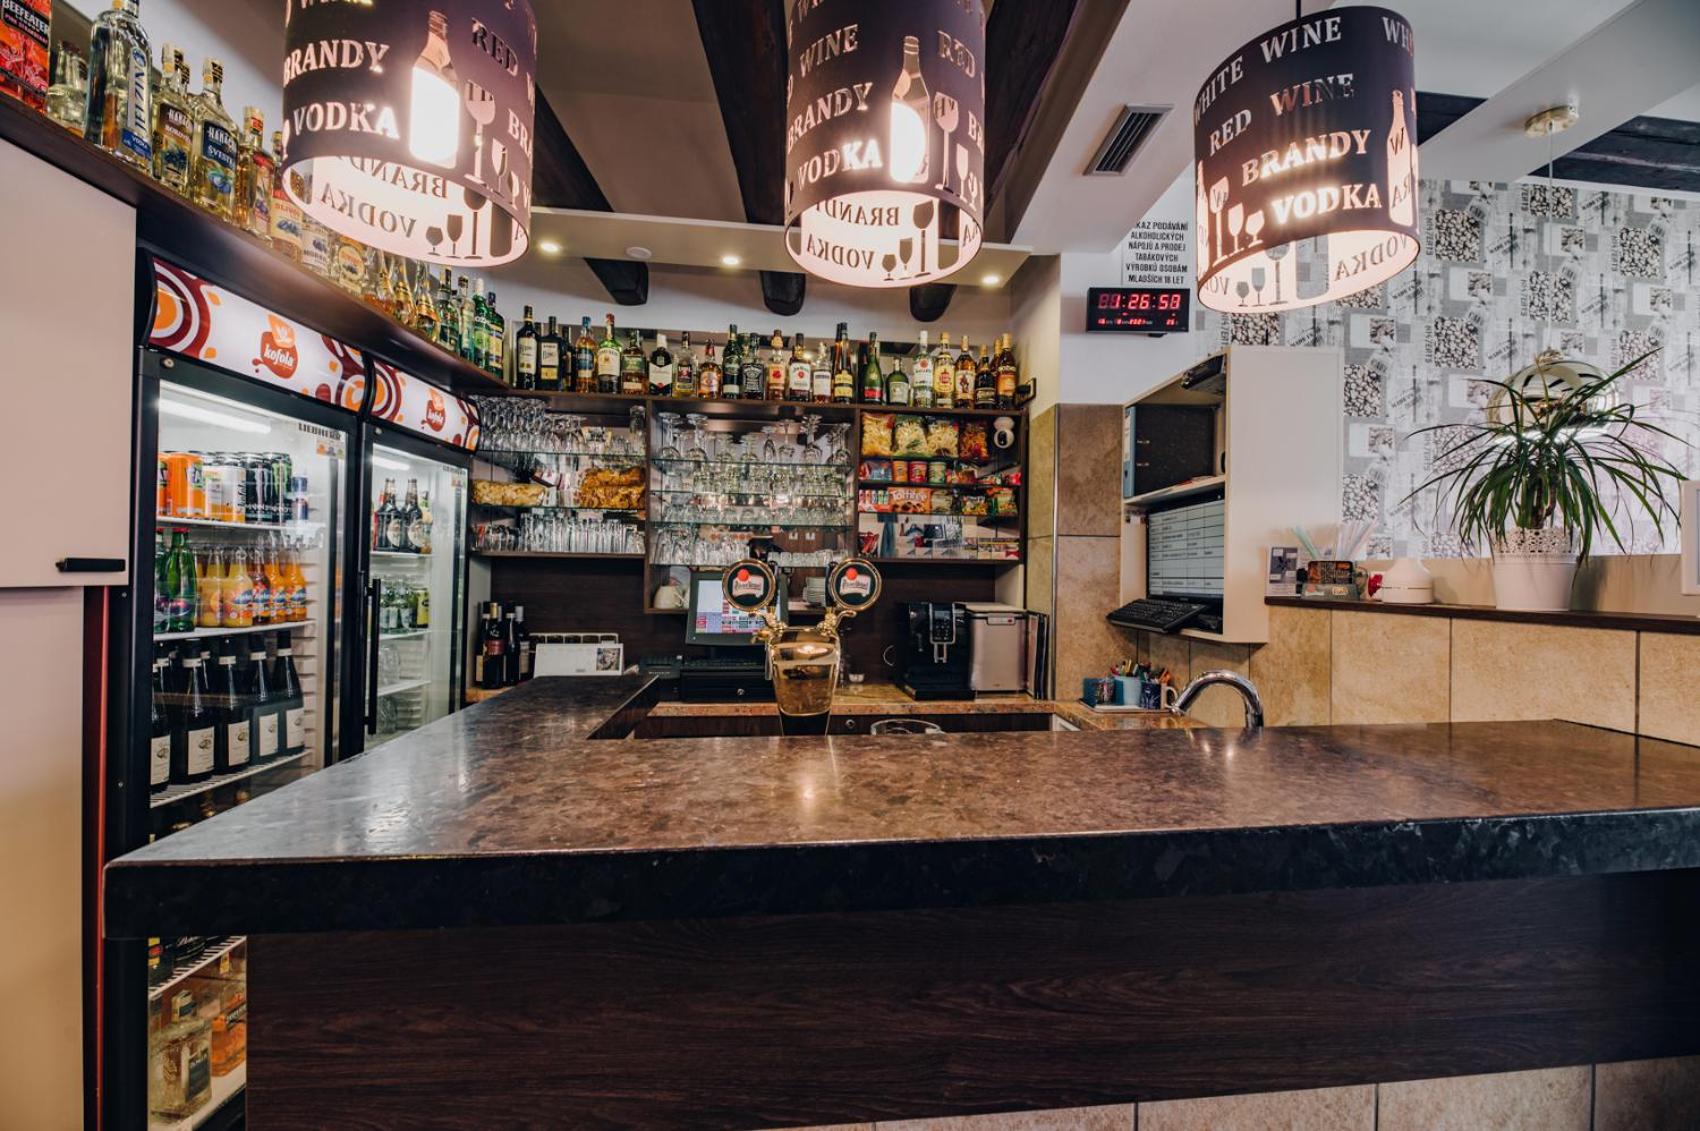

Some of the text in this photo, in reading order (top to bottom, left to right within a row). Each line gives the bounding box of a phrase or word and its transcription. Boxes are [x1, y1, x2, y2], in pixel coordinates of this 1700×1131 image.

[283, 39, 391, 88] BRANDY
[471, 17, 519, 77] RED
[799, 24, 859, 78] WINE
[937, 30, 975, 78] RED
[1194, 16, 1342, 126] WHITE WINE
[293, 101, 400, 140] VODKA
[788, 82, 874, 152] BRANDY
[1209, 73, 1354, 157] RED WINE
[796, 139, 883, 192] VODKA
[1241, 129, 1372, 187] BRANDY
[1270, 183, 1382, 225] VODKA
[1154, 242, 1160, 250] A
[1161, 242, 1186, 251] PRODEJ
[263, 343, 294, 369] kofola
